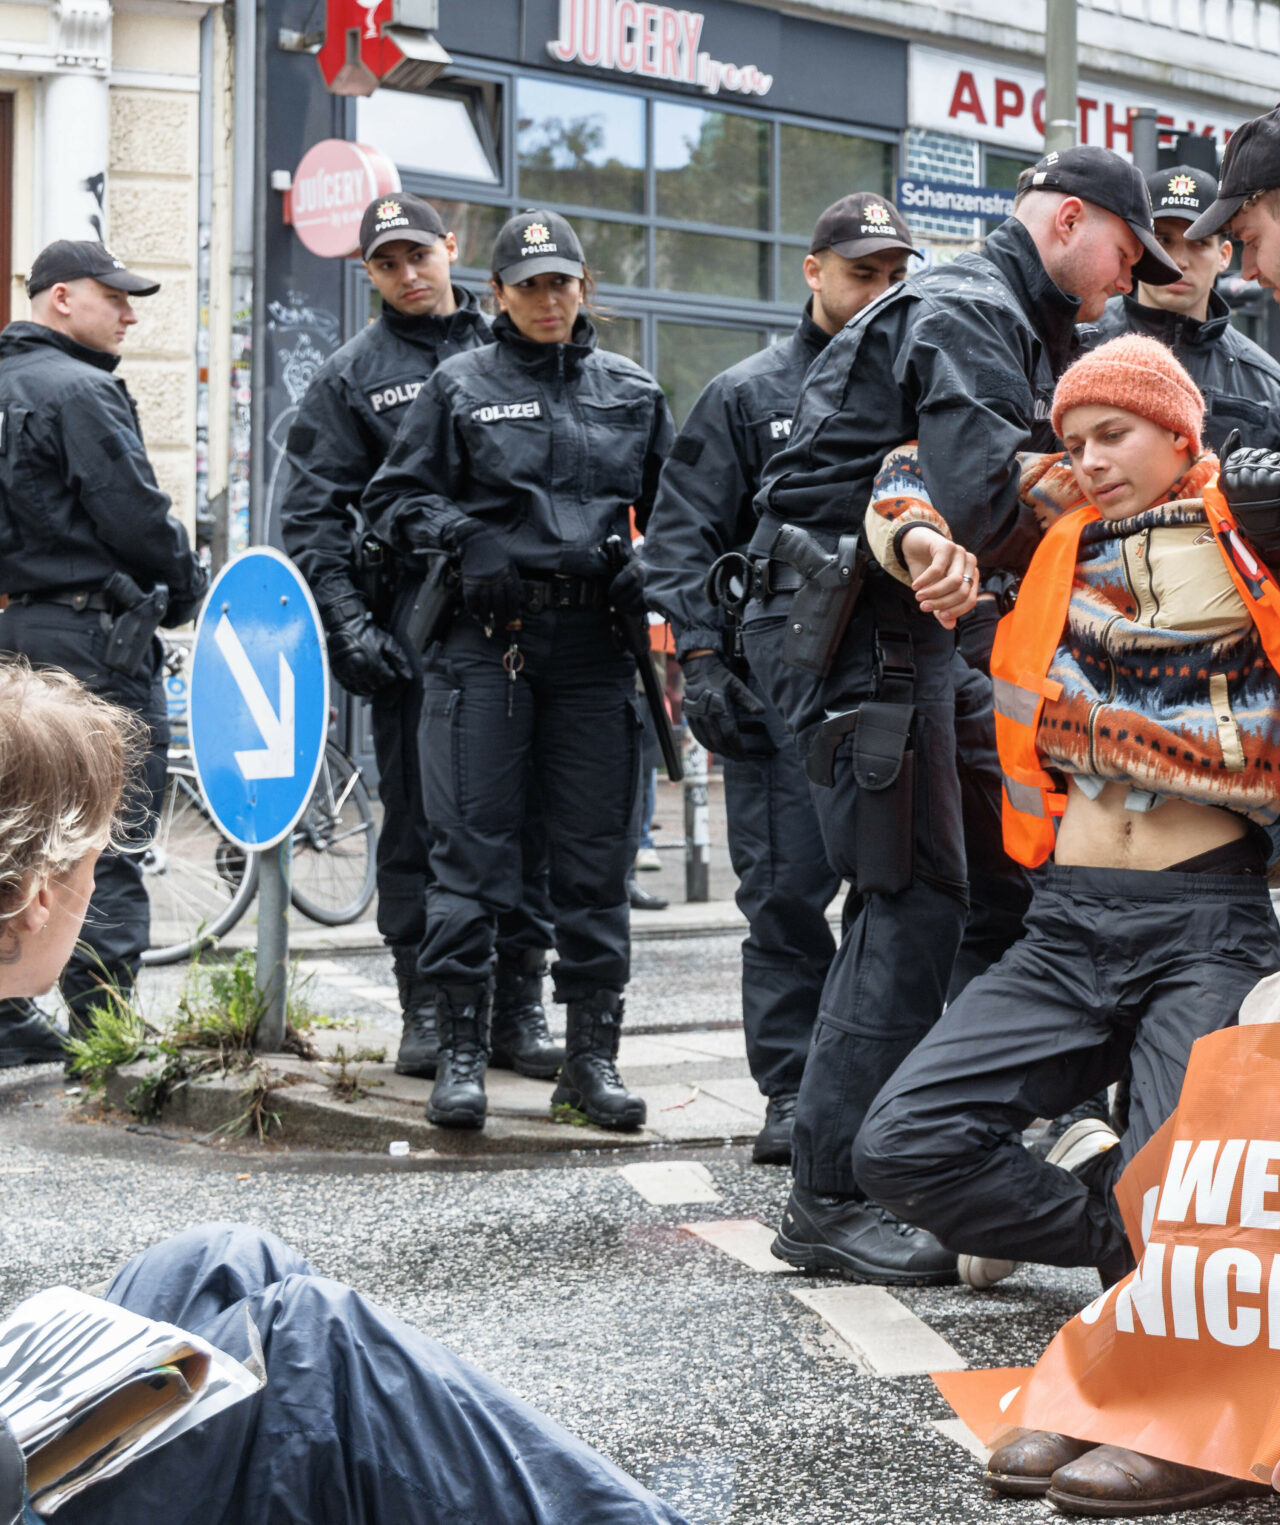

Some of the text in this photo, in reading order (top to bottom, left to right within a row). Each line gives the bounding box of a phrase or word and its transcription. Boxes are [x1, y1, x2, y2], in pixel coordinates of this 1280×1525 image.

[547, 0, 704, 84] JUICERY
[296, 168, 365, 214] JUICERY
[1161, 196, 1200, 208] POLIZEI
[375, 217, 410, 232] POLIZEI
[860, 224, 897, 236] POLIZEI
[521, 243, 558, 257] POLIZEI
